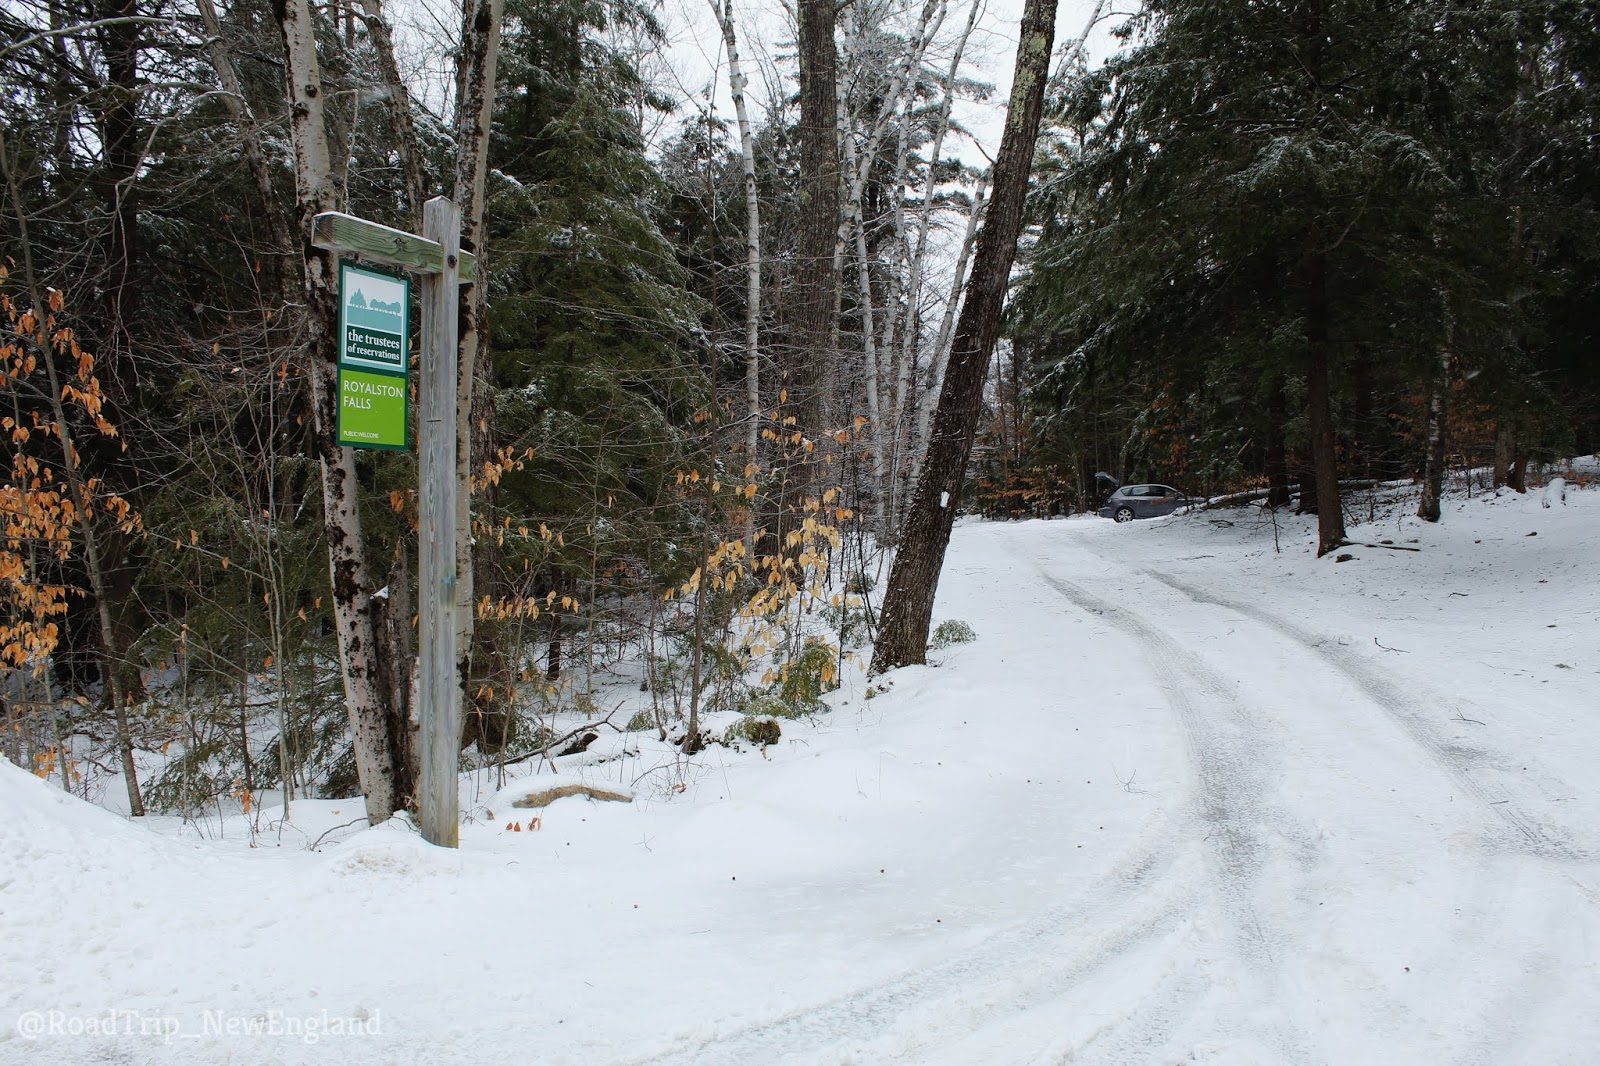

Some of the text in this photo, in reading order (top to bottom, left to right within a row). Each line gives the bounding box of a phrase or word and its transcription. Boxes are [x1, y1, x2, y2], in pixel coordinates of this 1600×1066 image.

[348, 329, 400, 349] the trustees
[348, 343, 400, 360] of reservations
[344, 380, 403, 398] ROYALSTON
[343, 396, 371, 410] FALLS
